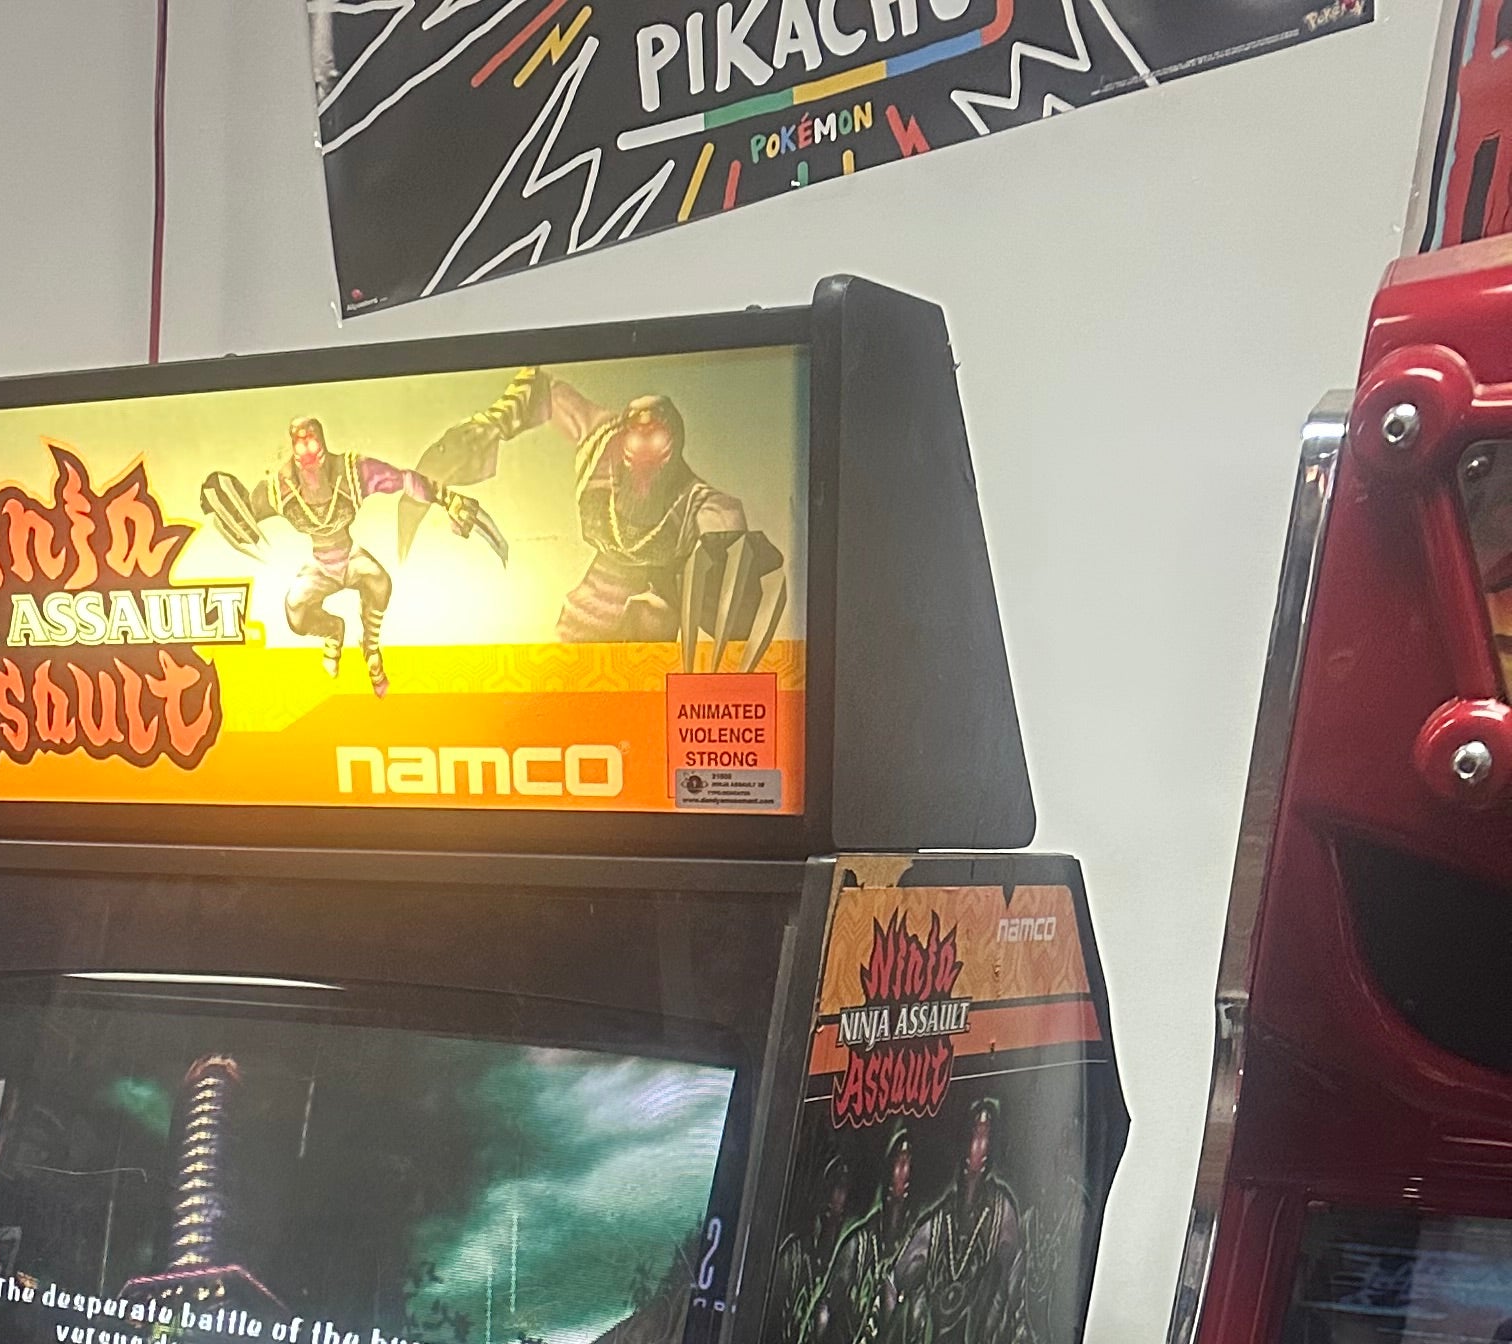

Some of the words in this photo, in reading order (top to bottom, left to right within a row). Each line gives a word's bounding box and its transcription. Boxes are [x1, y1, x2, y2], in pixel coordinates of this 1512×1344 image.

[750, 101, 874, 164] POKÉMON
[6, 586, 249, 648] ASSAULT
[677, 704, 766, 719] ANIMATED
[679, 727, 766, 743] VIOLENCE
[336, 744, 624, 797] namco
[685, 751, 758, 767] STRONG
[996, 916, 1056, 942] namco
[839, 1011, 890, 1050] NINJA
[895, 1002, 969, 1038] ASSAULT
[42, 1283, 173, 1324] desperate
[180, 1302, 262, 1338] battle
[272, 1317, 304, 1344] of
